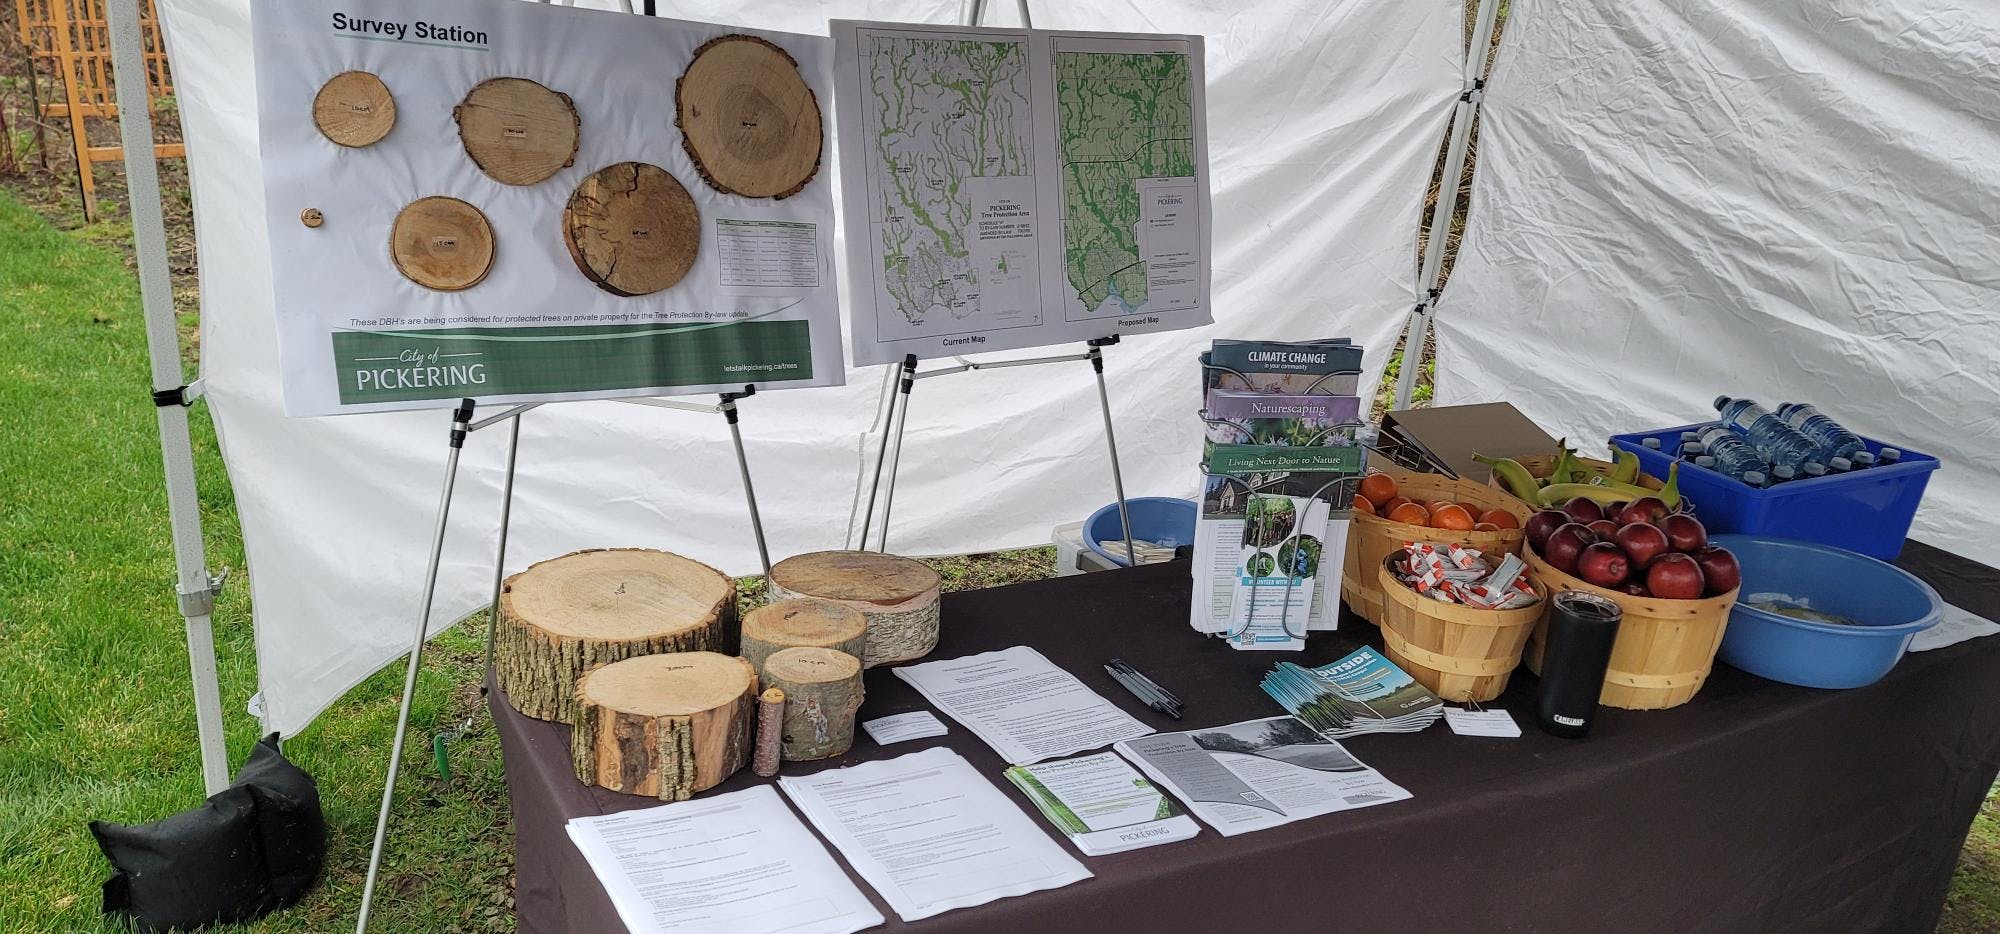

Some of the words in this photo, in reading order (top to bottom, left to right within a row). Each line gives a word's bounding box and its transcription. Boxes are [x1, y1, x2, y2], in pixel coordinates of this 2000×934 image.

[332, 12, 407, 41] Survey
[415, 21, 488, 44] Station
[989, 204, 1021, 212] PICKERING
[350, 318, 377, 326] These
[379, 317, 405, 326] DBH's
[423, 316, 446, 326] being
[448, 314, 491, 324] considered
[492, 315, 503, 323] for
[505, 314, 541, 325] protected
[542, 313, 561, 322] trees
[563, 314, 573, 322] on
[574, 313, 598, 323] private
[600, 313, 630, 323] property
[630, 311, 640, 320] for
[641, 311, 652, 319] the
[654, 311, 668, 319] Tree
[670, 311, 703, 319] Protection
[704, 311, 728, 320] By-law
[1118, 318, 1147, 328] Proposed
[1147, 316, 1159, 325] Map
[942, 336, 969, 346] Current
[970, 335, 986, 345] Map
[399, 348, 425, 367] City
[427, 346, 440, 364] of
[1248, 351, 1287, 362] CLIMATE
[1288, 352, 1327, 364] CHANGE
[723, 362, 798, 372] letstalkpickering.ca/trees
[1280, 363, 1308, 371] community
[356, 364, 487, 391] PICKERING
[1251, 402, 1326, 417] Naturescaping
[1228, 458, 1254, 468] Living
[1256, 457, 1276, 465] Next
[1278, 457, 1300, 465] Door
[1312, 455, 1341, 464] Nature
[1317, 651, 1373, 678] OUTSIDE
[1120, 827, 1170, 842] PICKERING
